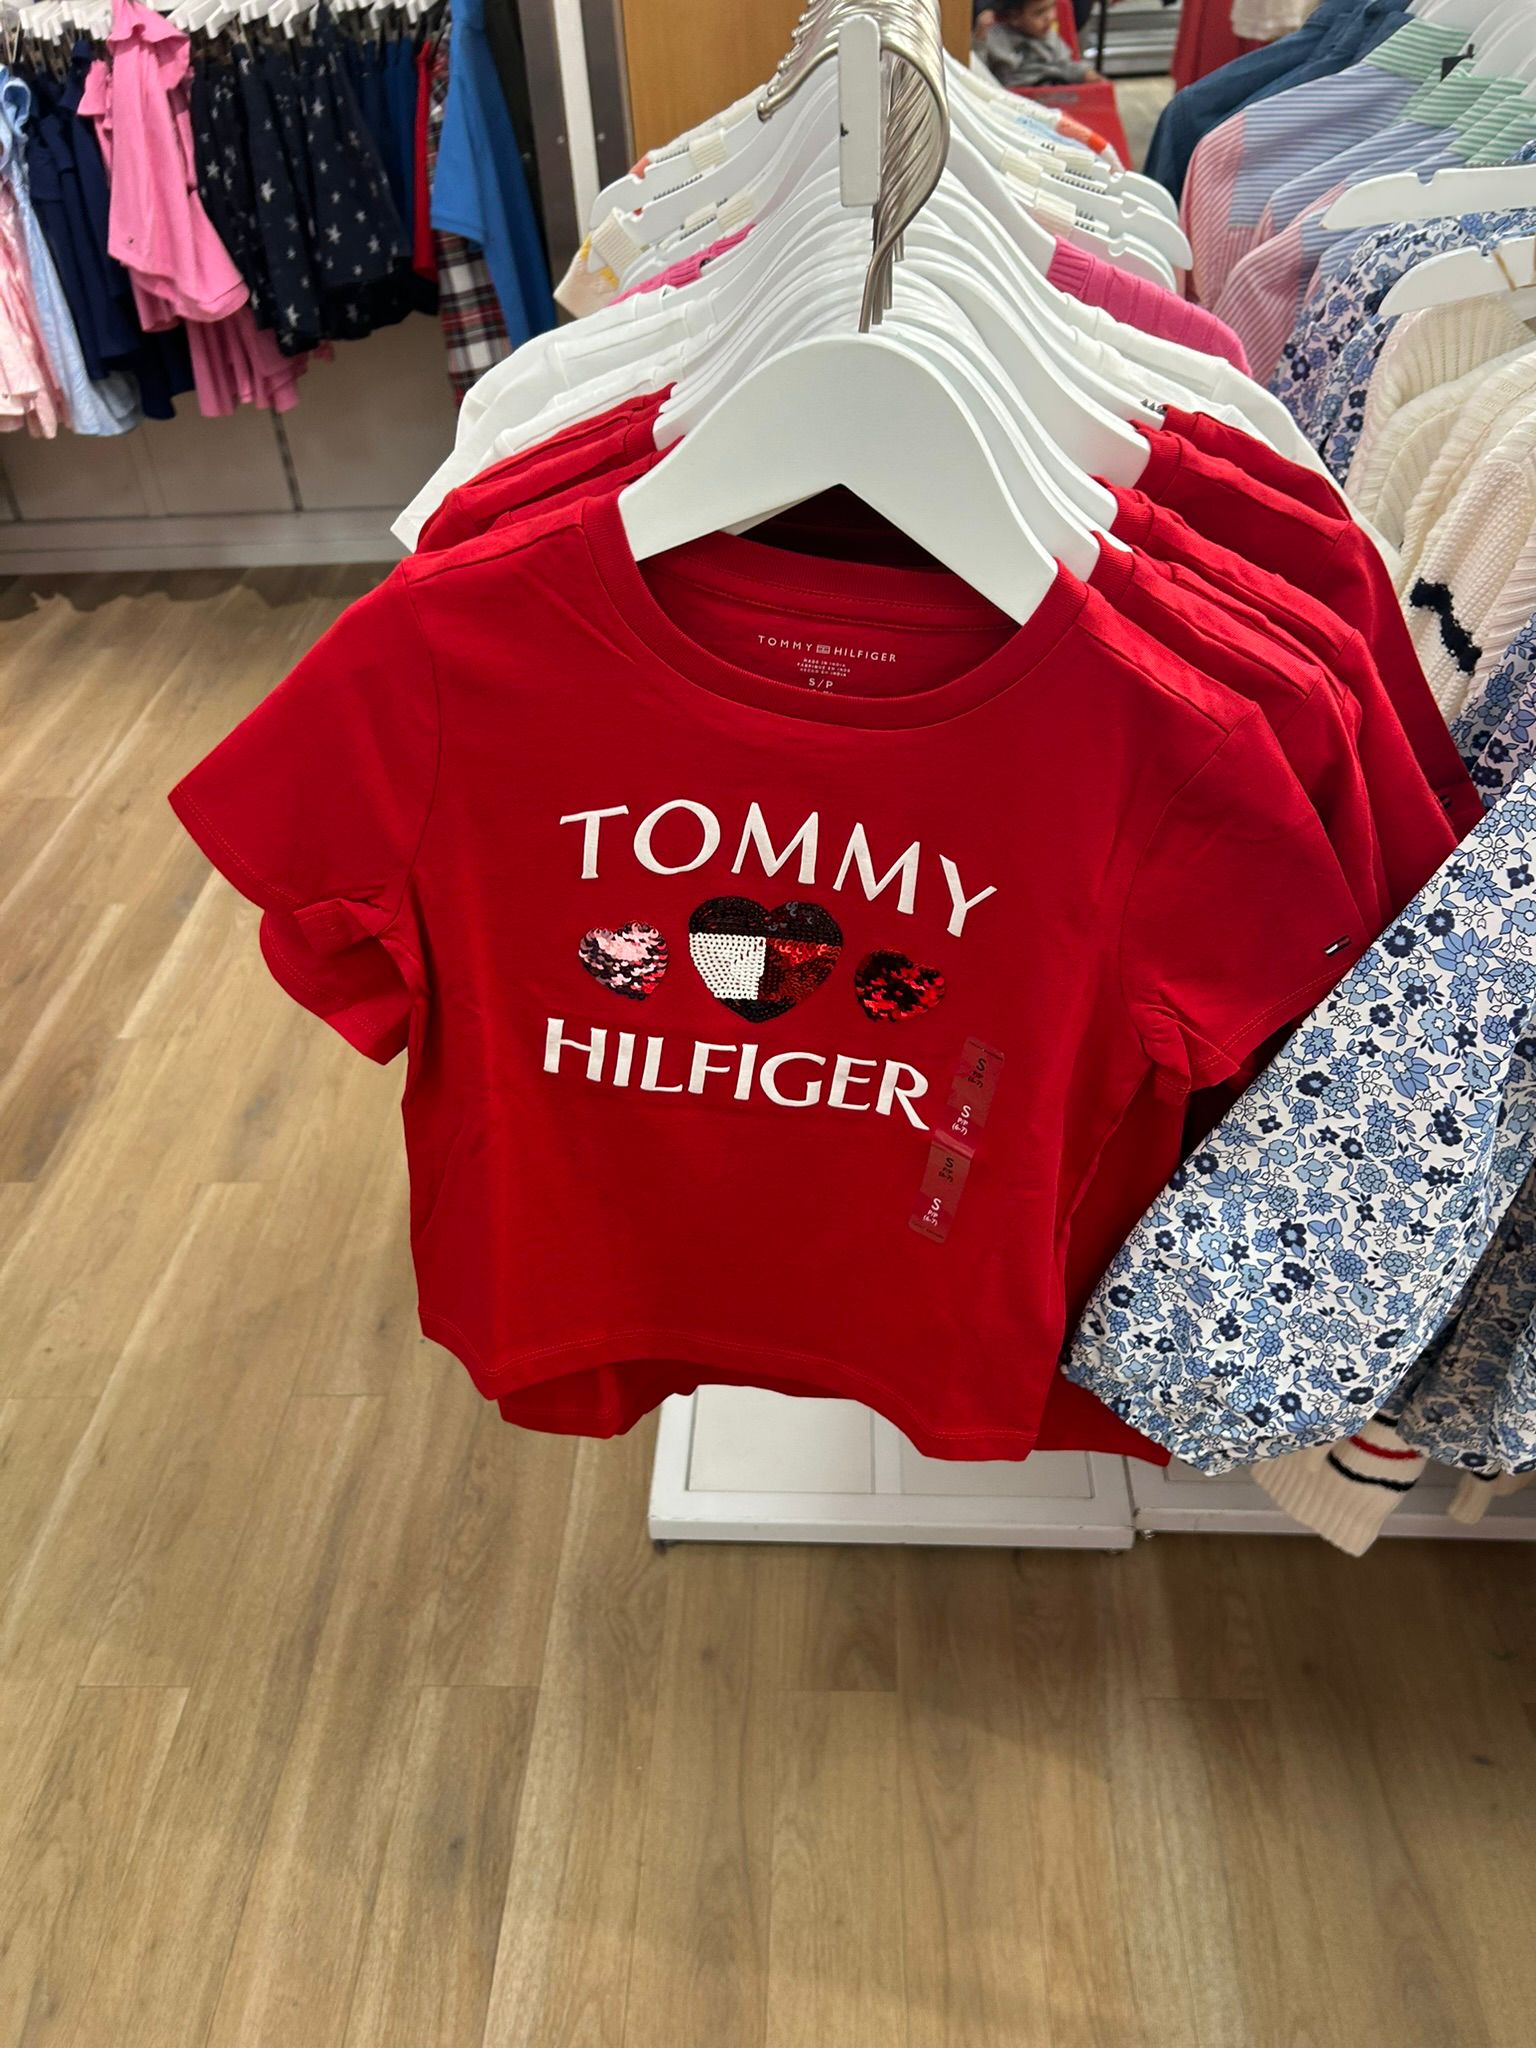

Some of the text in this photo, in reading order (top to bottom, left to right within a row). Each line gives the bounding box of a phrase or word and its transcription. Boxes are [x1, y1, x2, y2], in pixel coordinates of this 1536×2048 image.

[758, 634, 897, 663] TOMMY HILFIGER
[559, 799, 998, 938] TOMMY
[976, 1058, 987, 1072] S
[543, 1017, 930, 1132] HILFIGER
[961, 1104, 972, 1118] S
[945, 1157, 954, 1168] S
[931, 1197, 942, 1211] S
